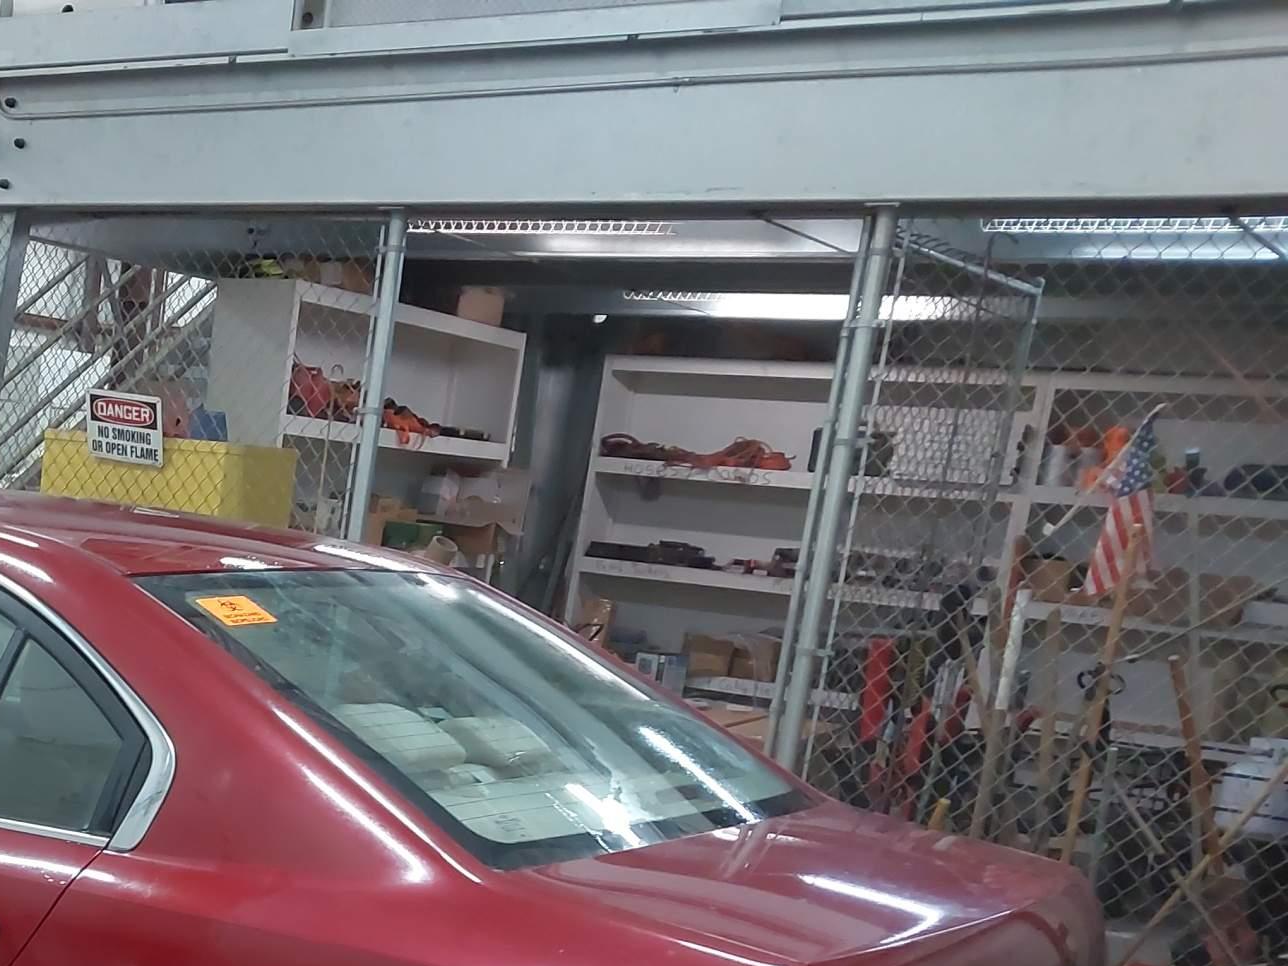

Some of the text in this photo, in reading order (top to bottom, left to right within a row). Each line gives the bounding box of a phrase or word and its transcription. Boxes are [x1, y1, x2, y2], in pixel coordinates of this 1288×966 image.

[97, 402, 150, 422] DANGER
[97, 425, 152, 446] NO SMOKING
[92, 439, 159, 462] OR OPEN FLAME
